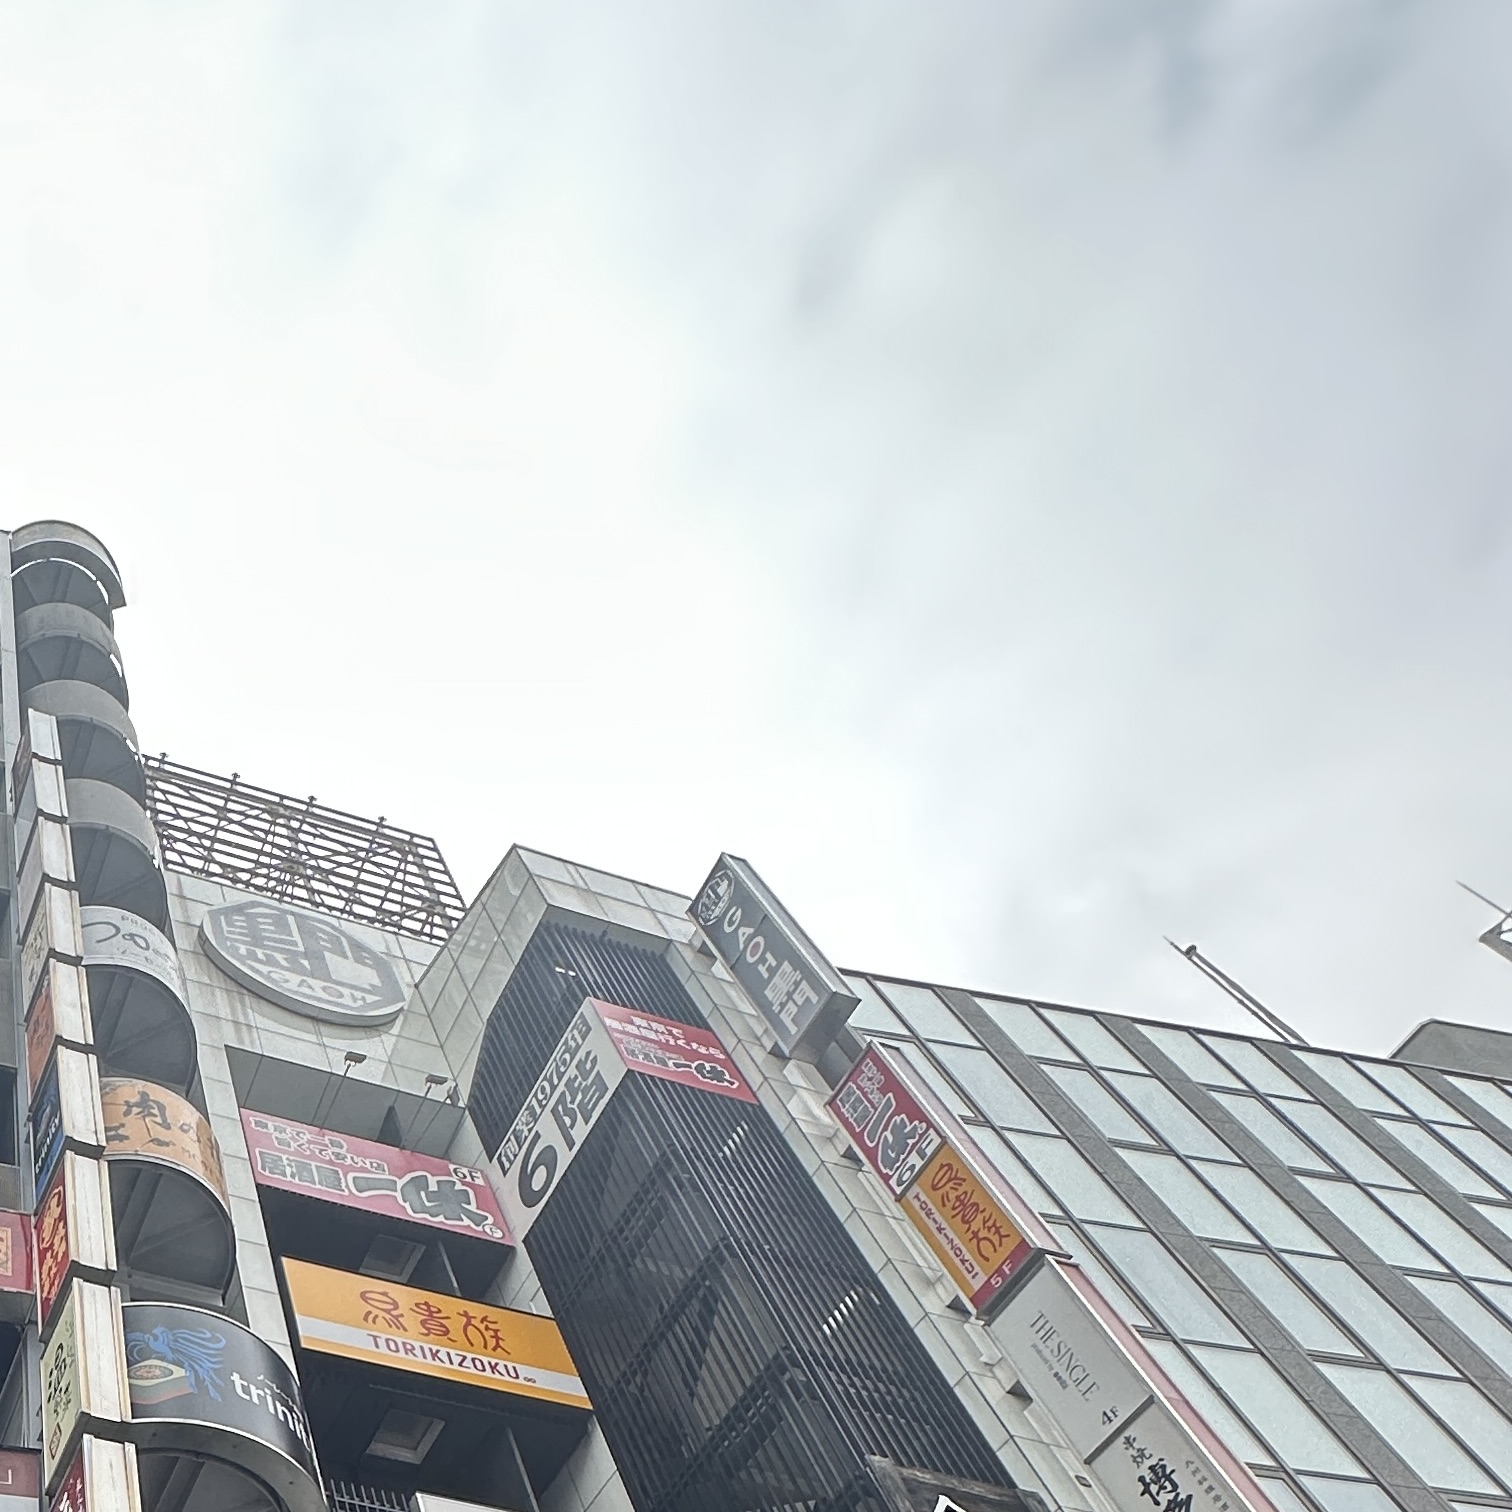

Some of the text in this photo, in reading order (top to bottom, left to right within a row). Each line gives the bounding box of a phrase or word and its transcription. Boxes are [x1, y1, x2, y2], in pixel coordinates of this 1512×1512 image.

[501, 1011, 594, 1176] 創業1975年
[518, 1048, 610, 1209] 6階
[255, 1148, 348, 1195] 居酒屋
[452, 1165, 482, 1184] 6F
[897, 1136, 935, 1188] 6F
[912, 1191, 976, 1276] TORIKIZOKU
[989, 1260, 1014, 1288] 5F
[359, 1289, 512, 1356] 鳥貴族
[367, 1332, 521, 1381] TORIKIZOKU
[1122, 1434, 1153, 1470] 串焼
